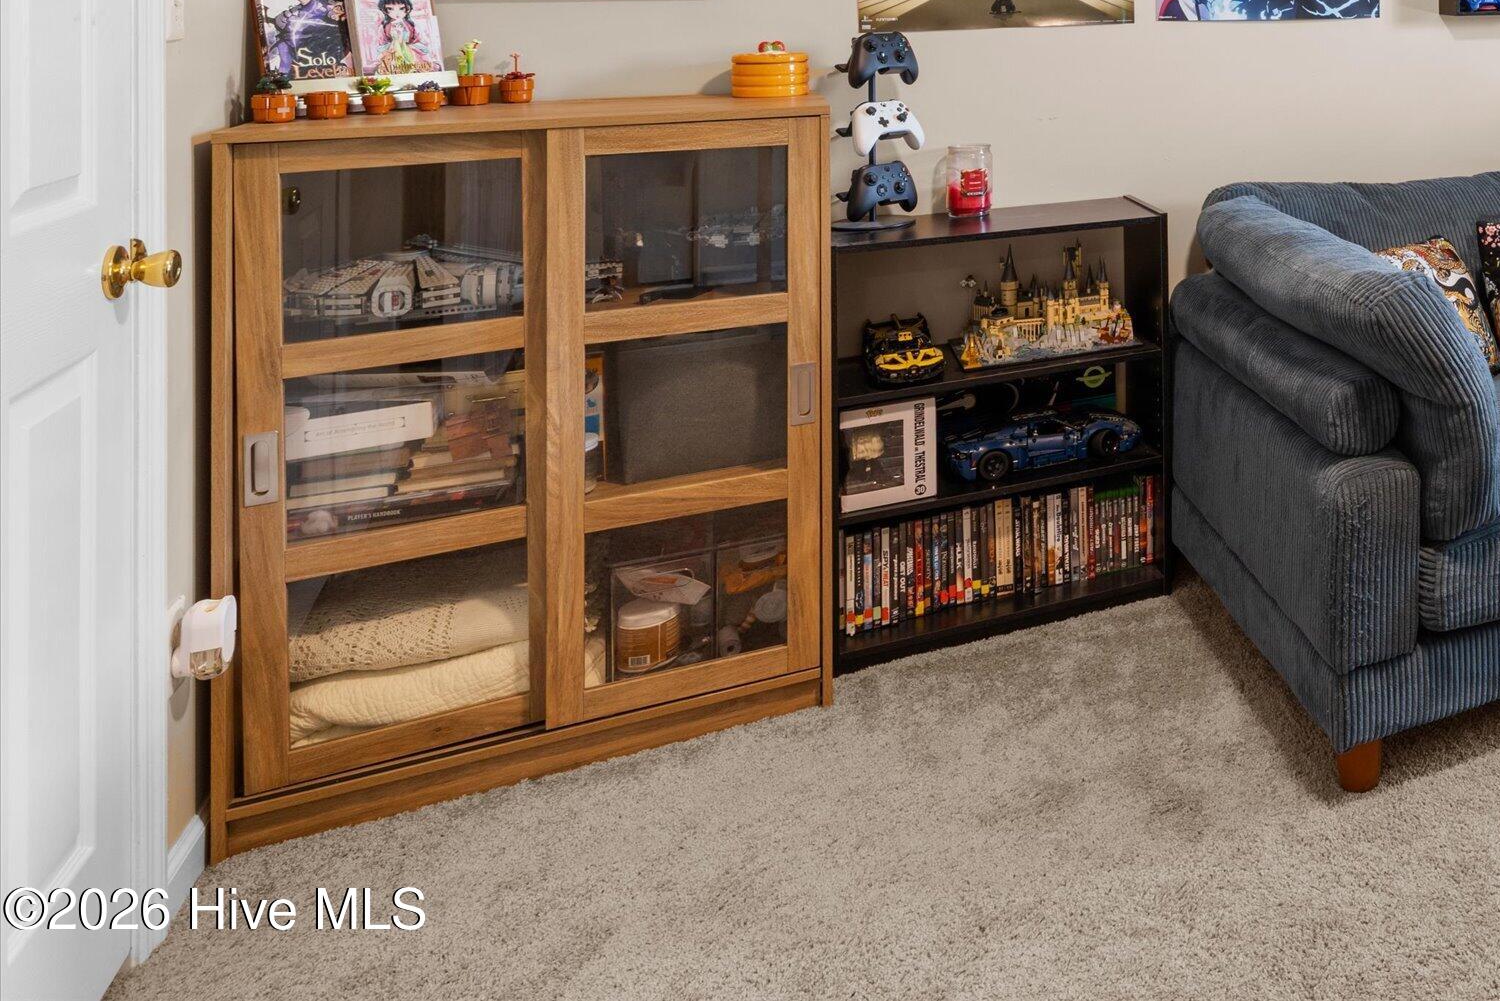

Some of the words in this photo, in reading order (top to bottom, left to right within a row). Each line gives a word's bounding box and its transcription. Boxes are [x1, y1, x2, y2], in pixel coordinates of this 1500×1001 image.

[293, 47, 337, 67] Solo
[913, 402, 926, 447] GRINDELWALD
[914, 450, 927, 484] THESTRAL
[347, 511, 372, 521] PLAYER'S
[372, 508, 402, 518] HANDBOOK
[955, 542, 963, 569] HULK
